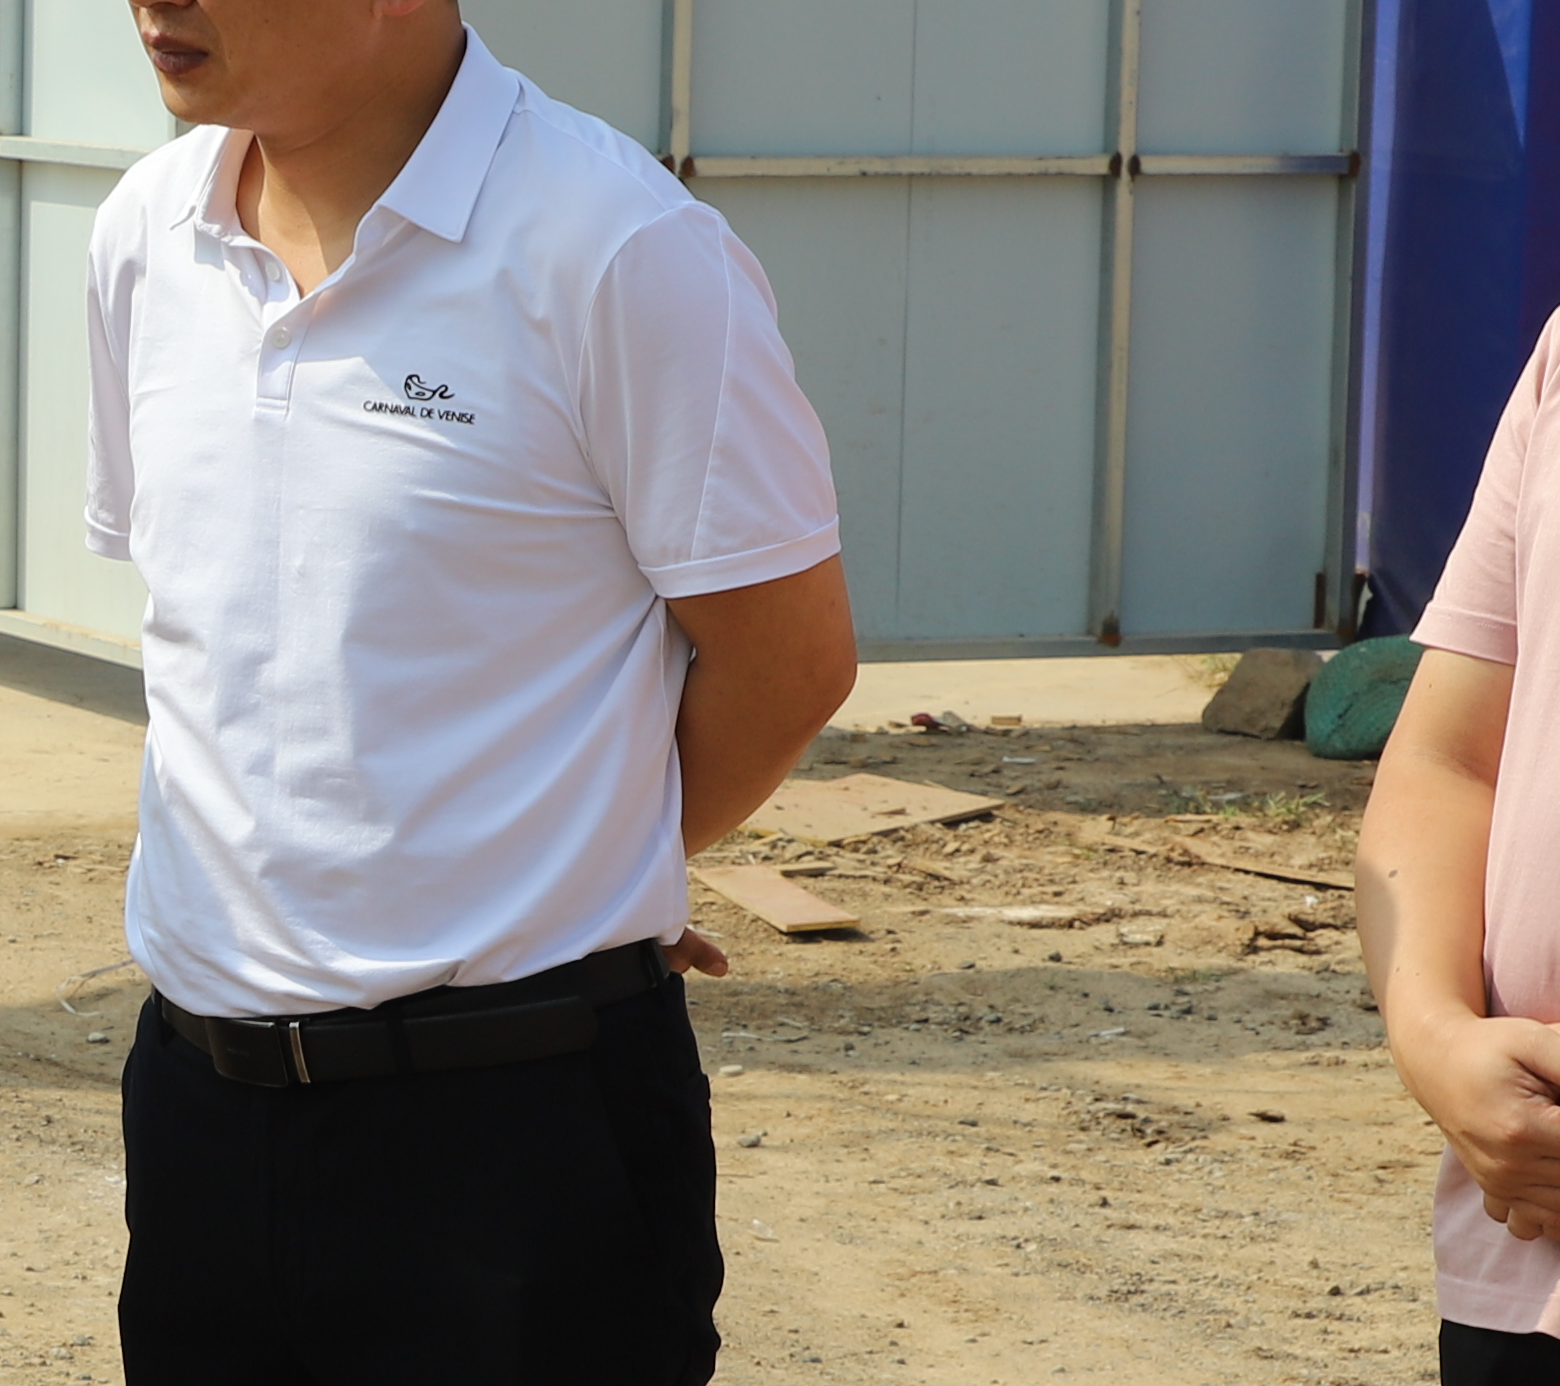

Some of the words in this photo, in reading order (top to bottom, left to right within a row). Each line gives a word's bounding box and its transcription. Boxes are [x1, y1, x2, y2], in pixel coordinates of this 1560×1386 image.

[363, 400, 417, 417] CARNAVAL
[420, 408, 434, 419] DE
[437, 409, 476, 425] VENISE
